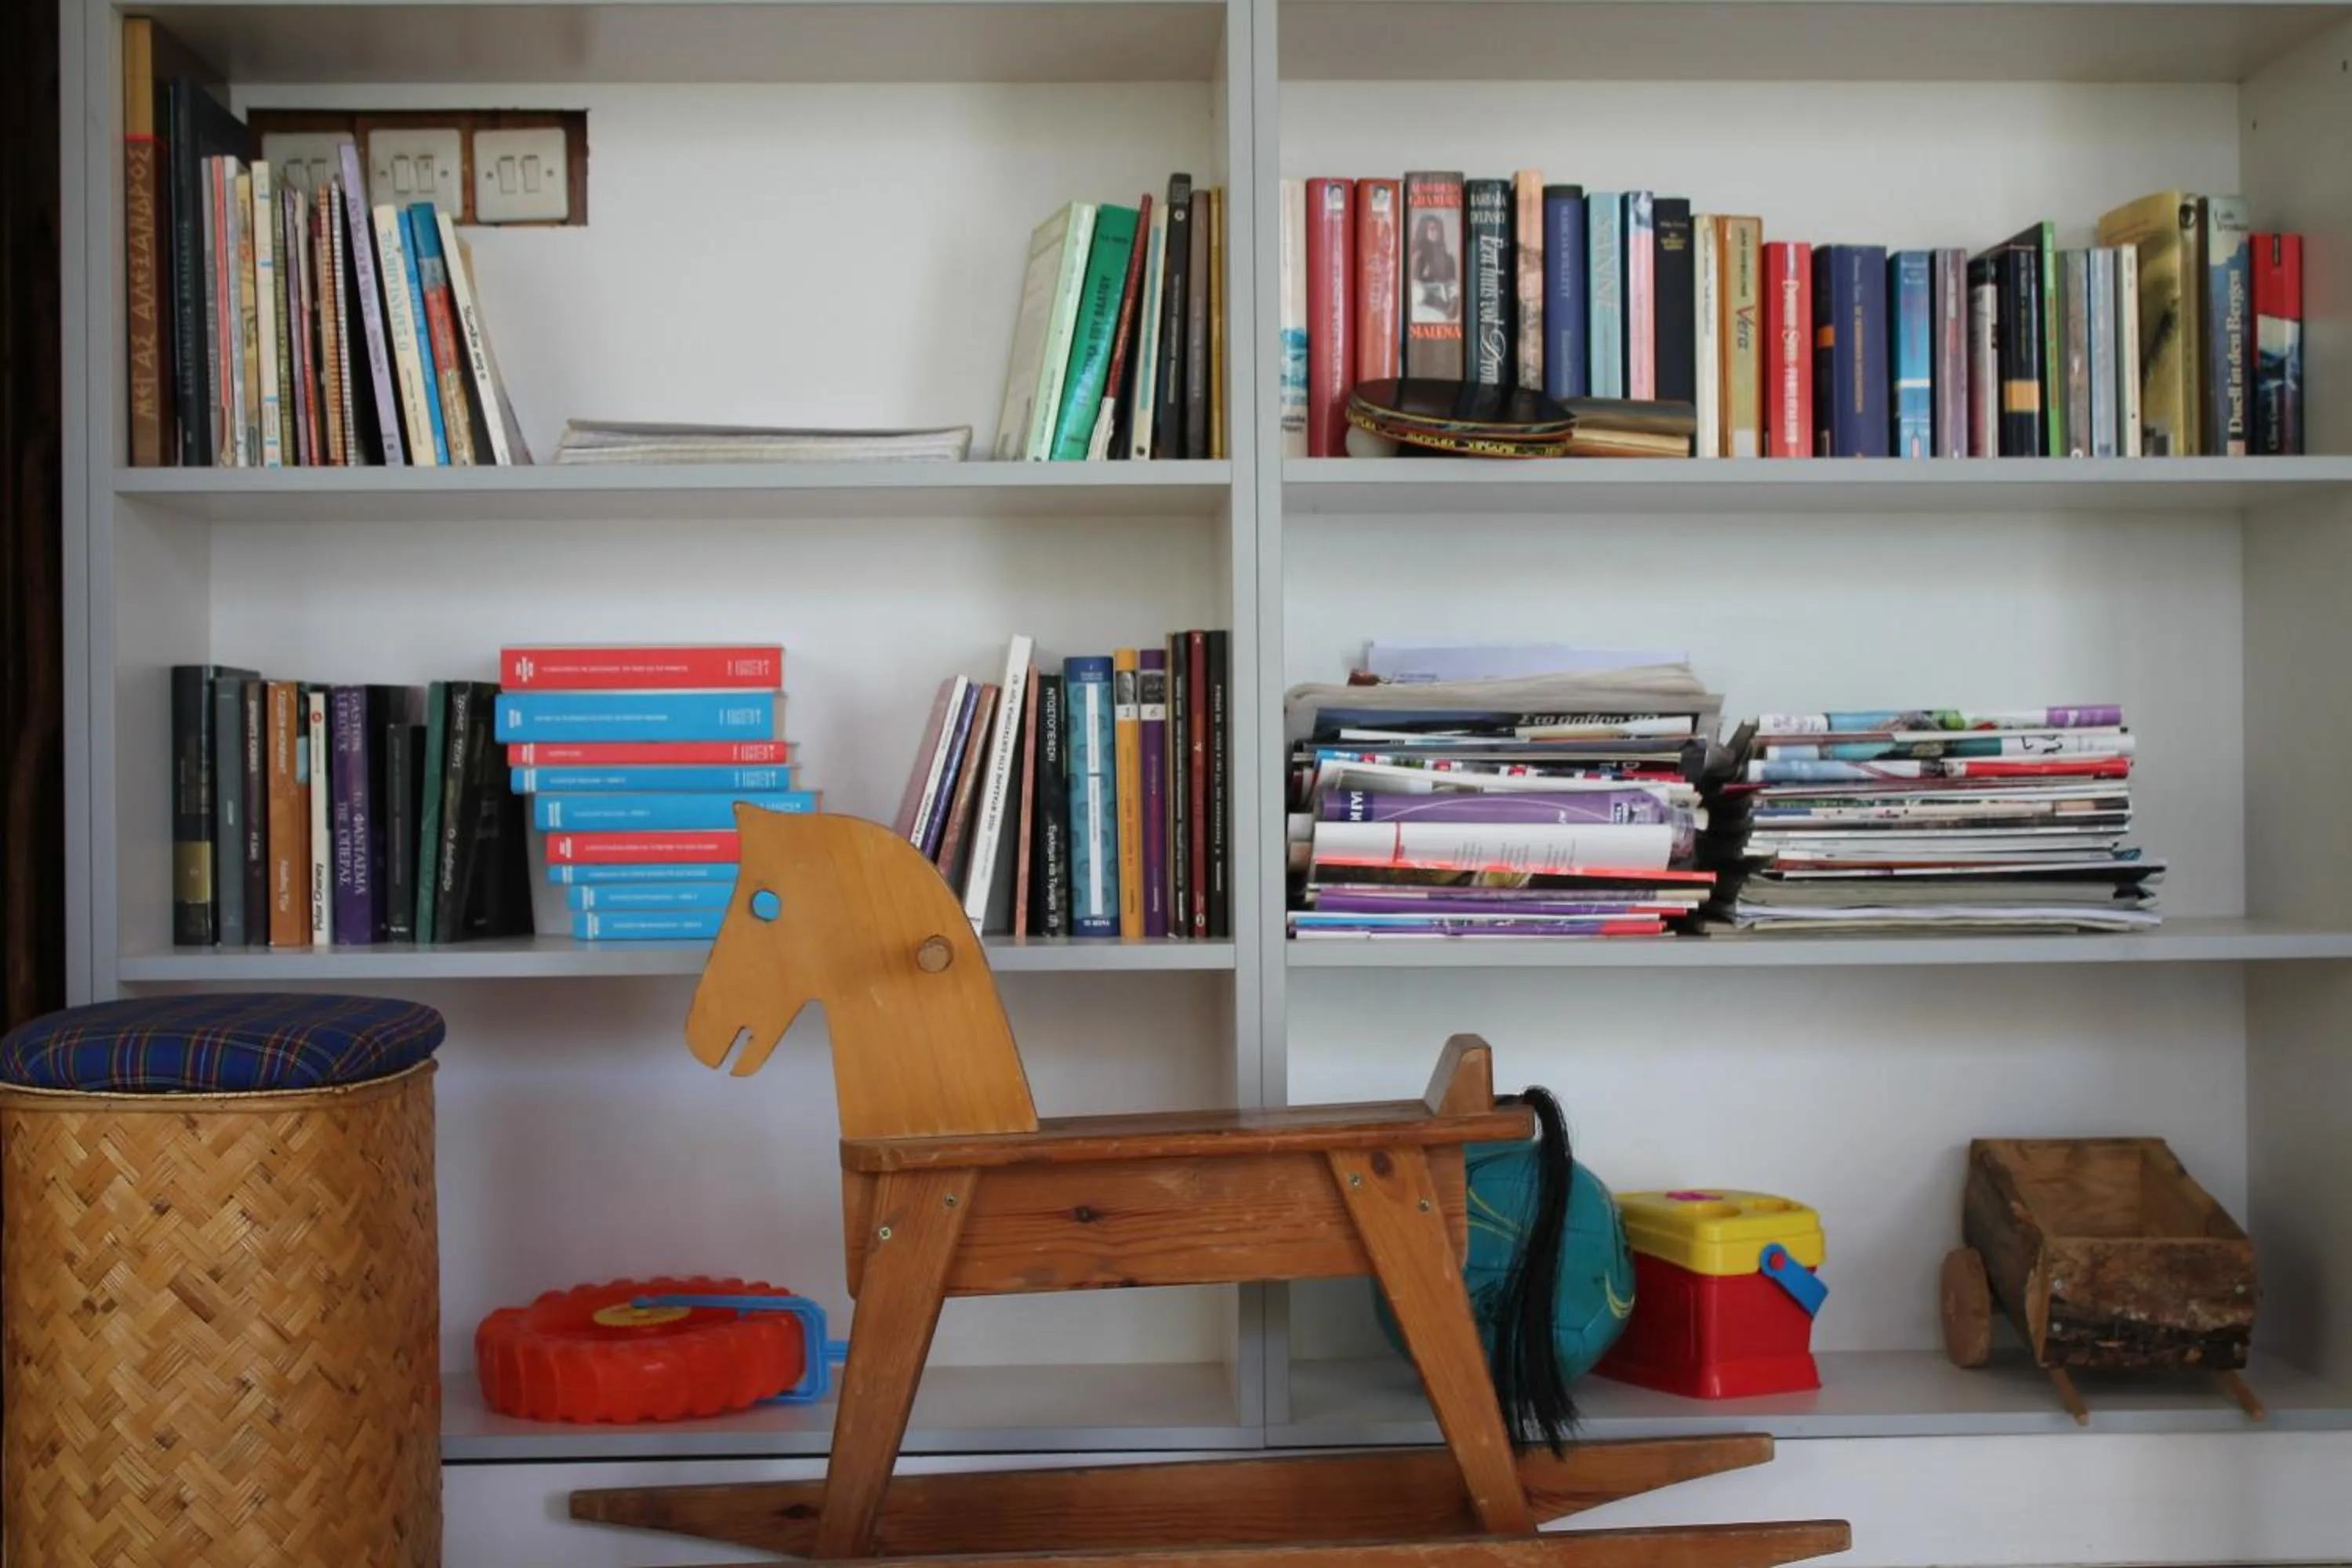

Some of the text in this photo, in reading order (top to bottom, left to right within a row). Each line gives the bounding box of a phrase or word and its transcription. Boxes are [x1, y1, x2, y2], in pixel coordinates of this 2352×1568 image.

[1735, 305, 1757, 350] Vera
[2226, 270, 2245, 433] Duell in den Bergen
[337, 692, 348, 751] LEROUX
[350, 692, 361, 752] GASTON
[1518, 713, 1555, 726] Στο
[339, 828, 351, 886] ΟΠΕΡΑΣ
[353, 813, 366, 895] ΦΑΝΤΑΣΜΑ
